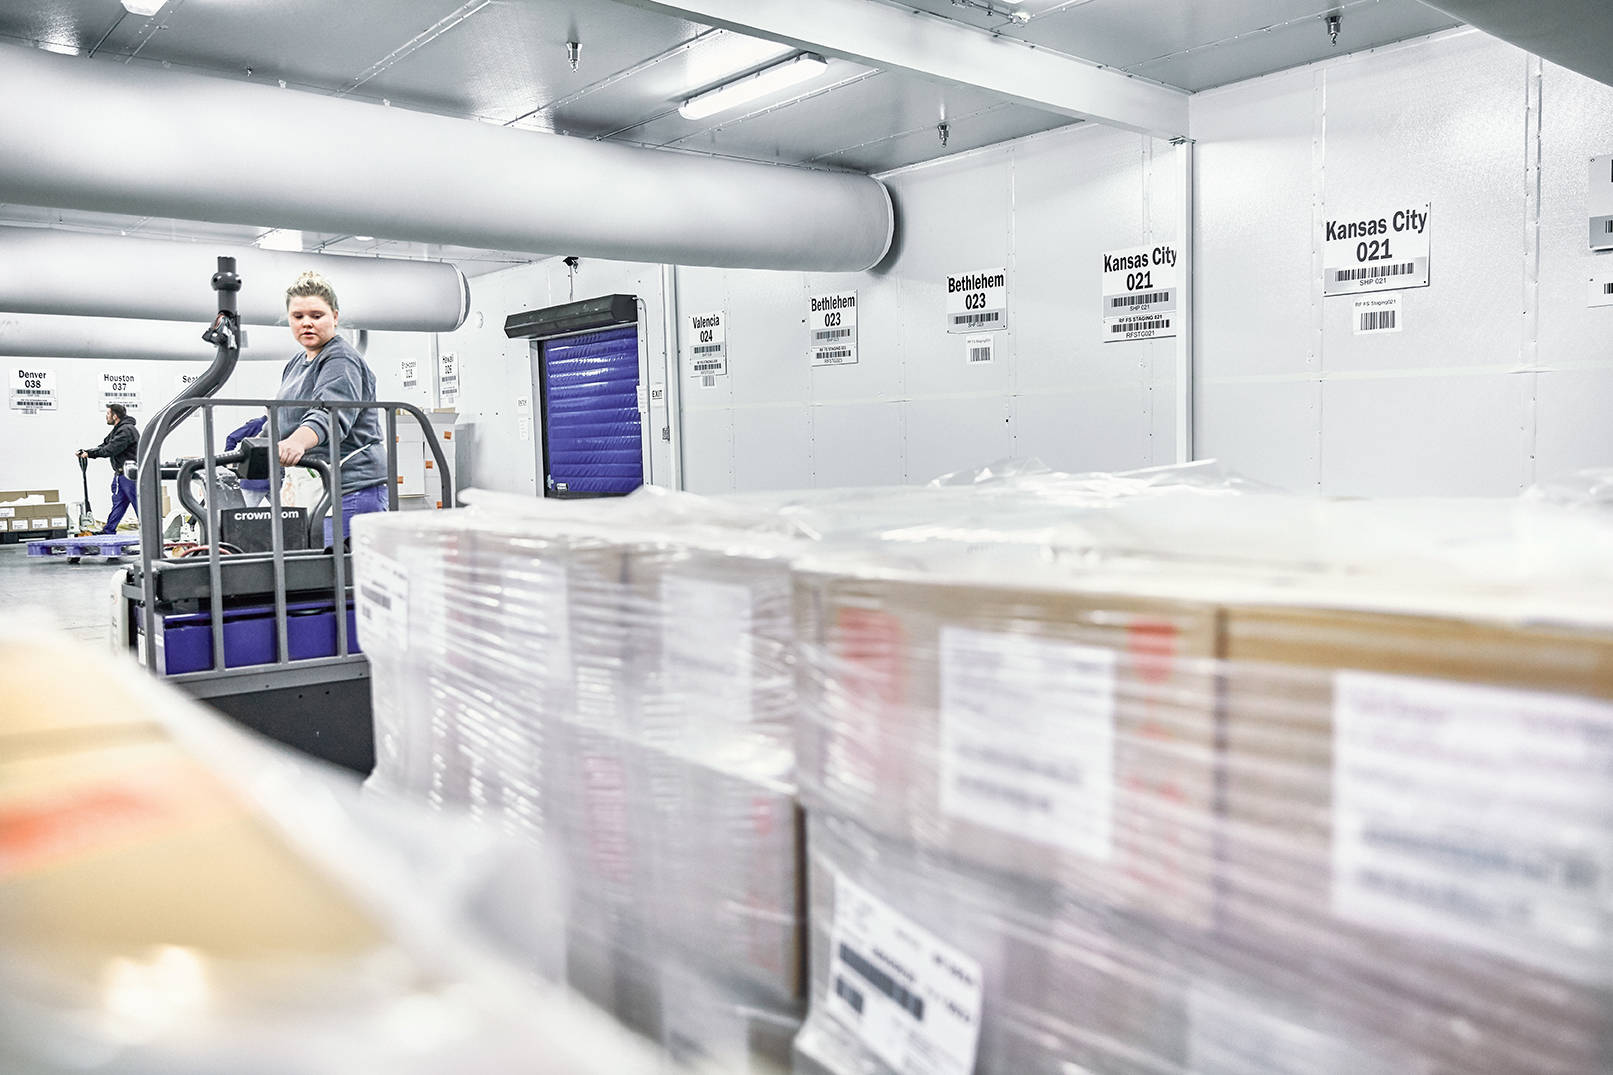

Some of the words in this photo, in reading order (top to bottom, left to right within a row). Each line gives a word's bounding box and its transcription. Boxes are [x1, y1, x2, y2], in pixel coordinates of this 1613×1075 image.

[1326, 218, 1387, 241] Kansas
[1392, 209, 1427, 234] City
[1356, 238, 1393, 262] 021
[1104, 253, 1149, 273] Kansas
[1152, 246, 1177, 267] City
[948, 273, 1004, 293] Bethlehem
[1126, 270, 1153, 291] 021
[811, 294, 855, 312] Bethlehem
[965, 292, 986, 310] 023
[692, 314, 720, 329] Valencia
[824, 312, 841, 327] 023
[699, 329, 713, 343] 024
[18, 369, 47, 379] Denver
[103, 373, 135, 382] Houston
[24, 379, 41, 389] 038
[112, 382, 127, 391] 037
